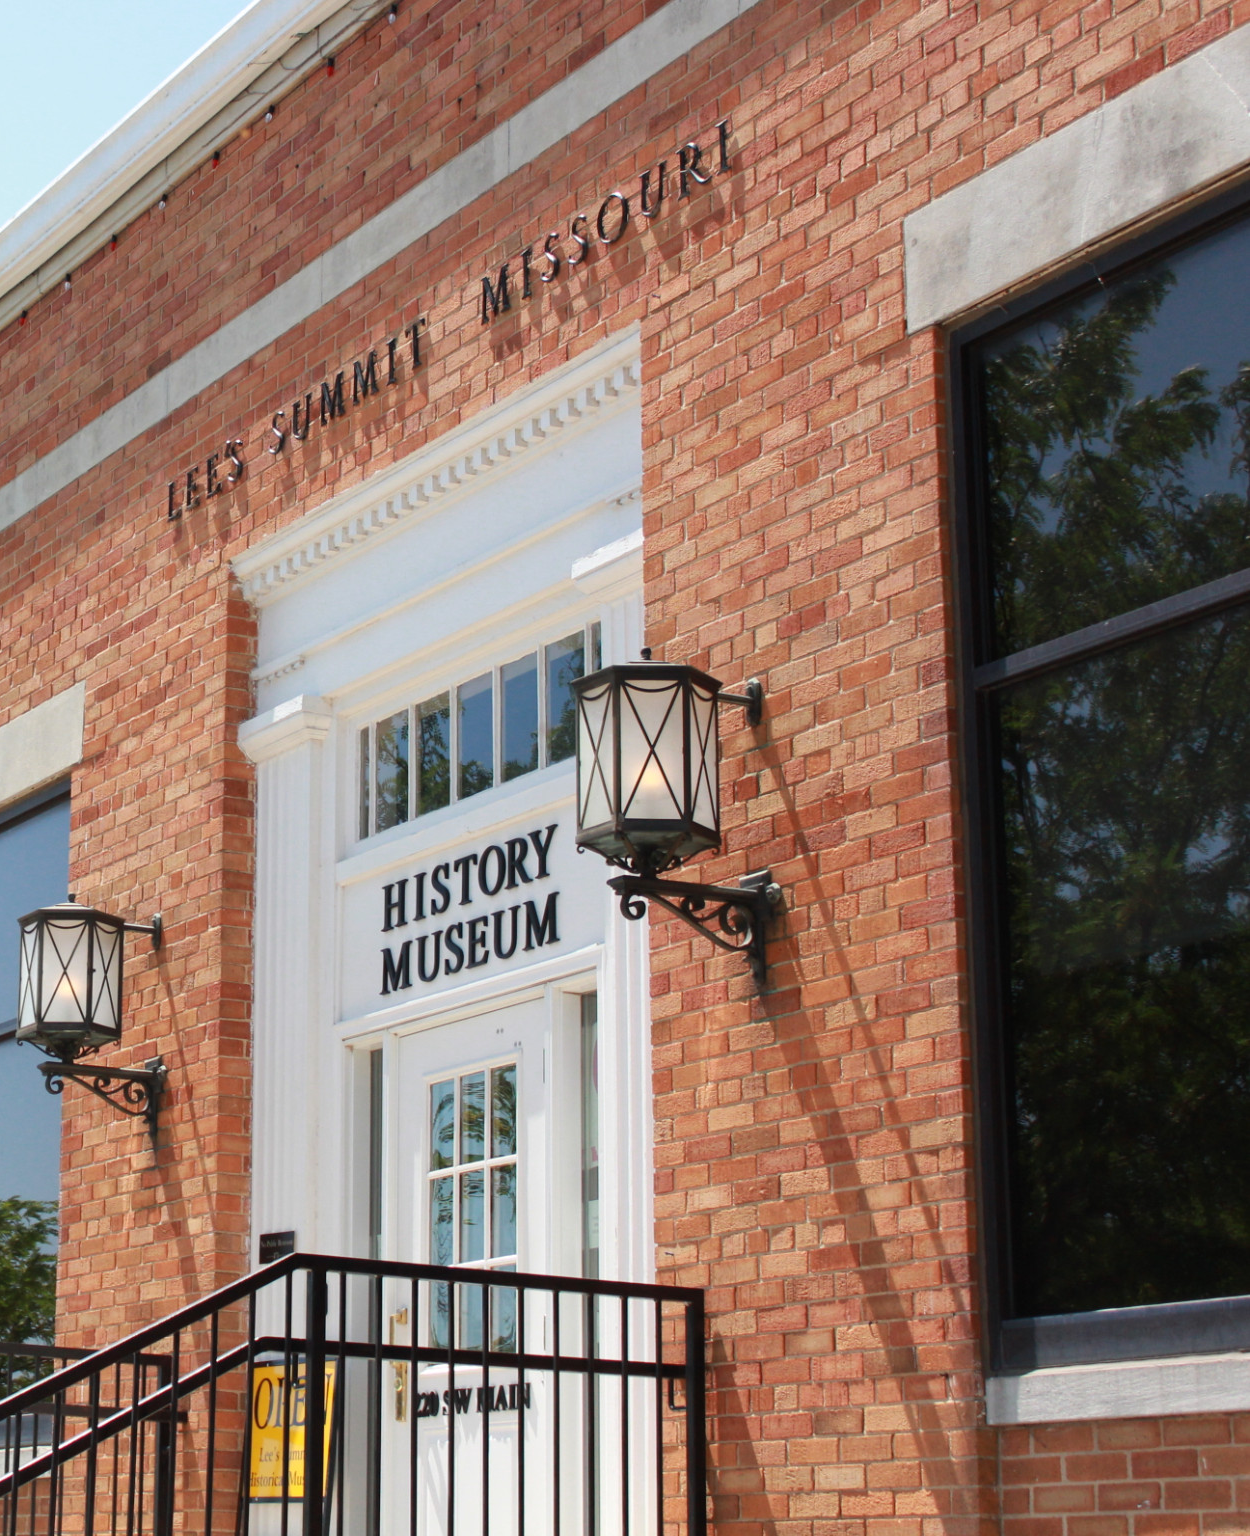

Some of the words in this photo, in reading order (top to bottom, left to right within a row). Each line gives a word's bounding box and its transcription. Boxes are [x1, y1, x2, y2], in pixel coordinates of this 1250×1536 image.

[168, 439, 243, 522] LEE'S
[268, 318, 426, 455] SUMMIT
[481, 119, 732, 326] MISSOURI
[381, 824, 558, 932] HISTORY
[379, 891, 561, 996] MUSEUM
[442, 1388, 472, 1416] SW
[476, 1382, 531, 1413] MAIN
